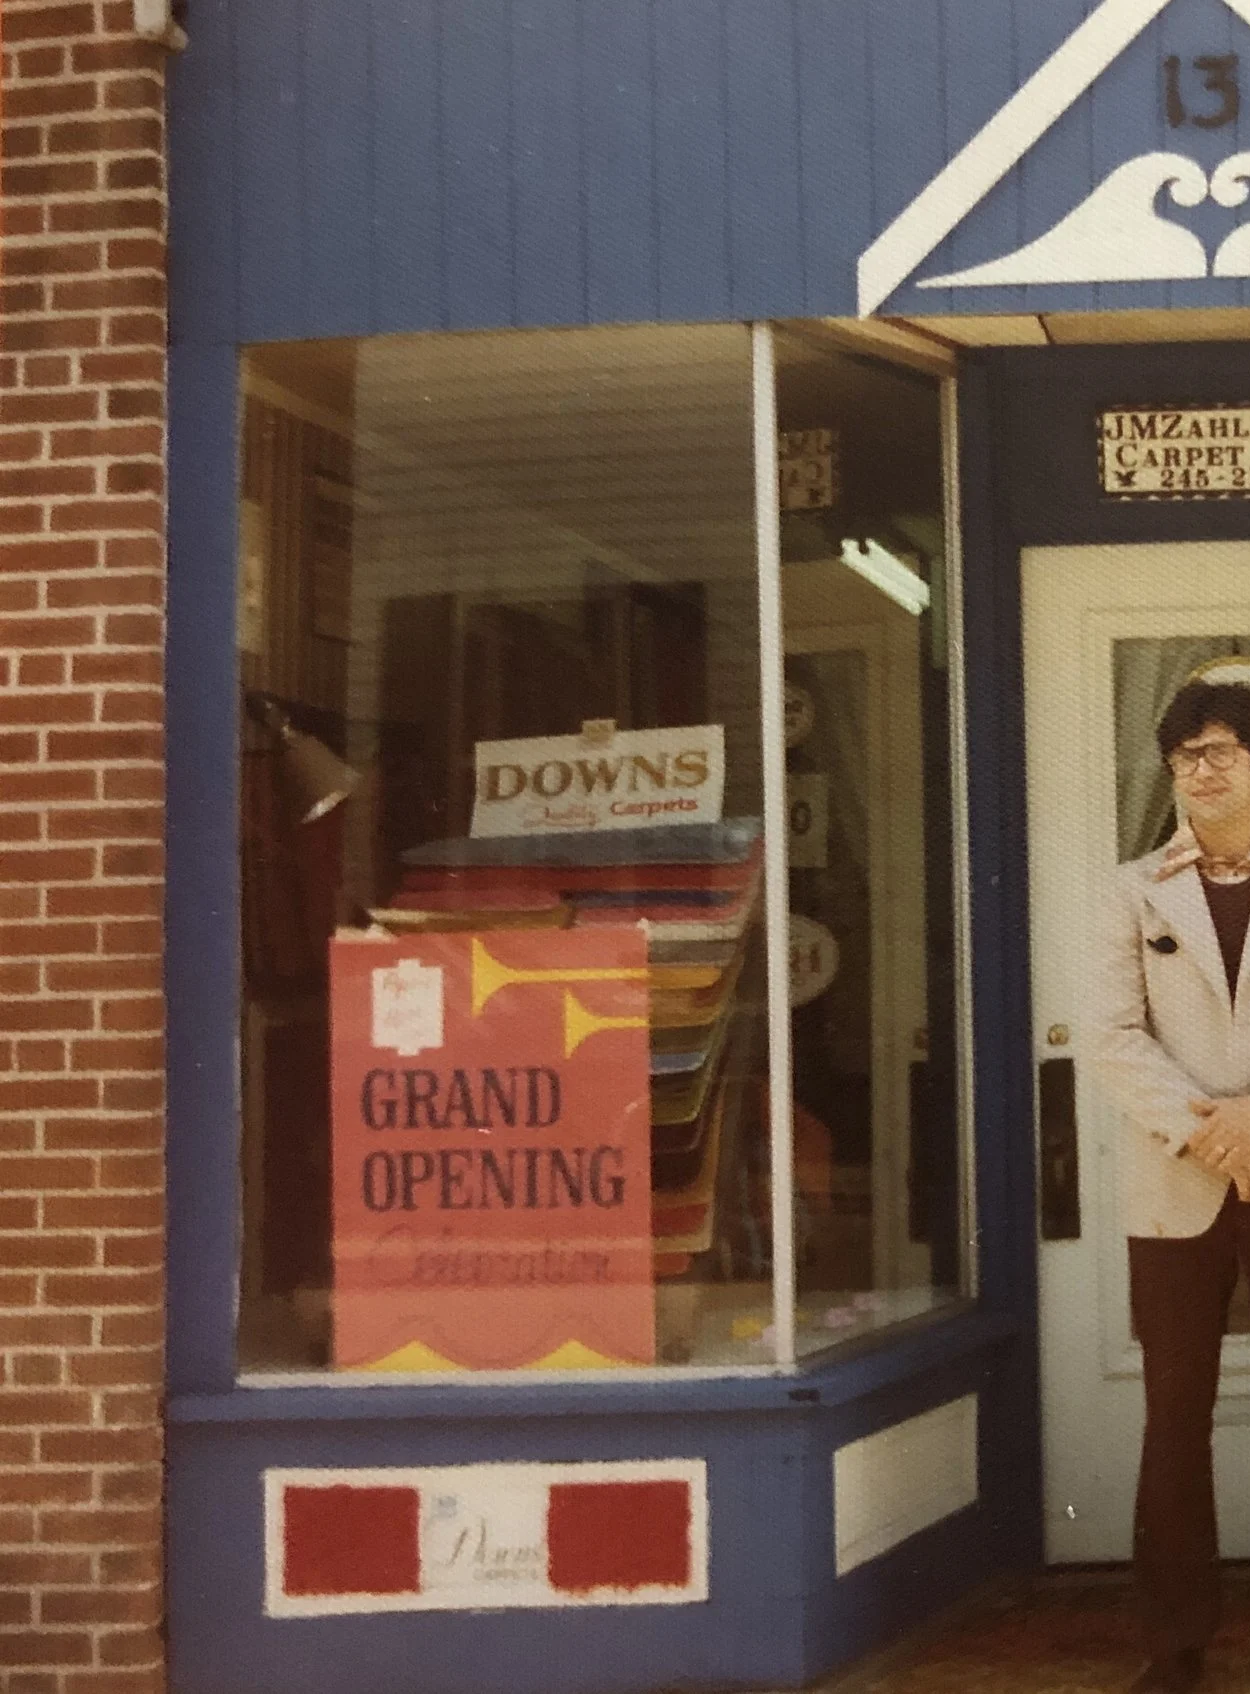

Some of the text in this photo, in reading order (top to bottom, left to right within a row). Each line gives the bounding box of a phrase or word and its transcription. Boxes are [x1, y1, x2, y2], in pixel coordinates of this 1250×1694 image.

[1163, 53, 1240, 130] 13
[1116, 443, 1245, 468] CARPET
[485, 750, 710, 803] DOWNS
[360, 1065, 562, 1132] GRAND
[361, 1145, 627, 1213] OPENING
